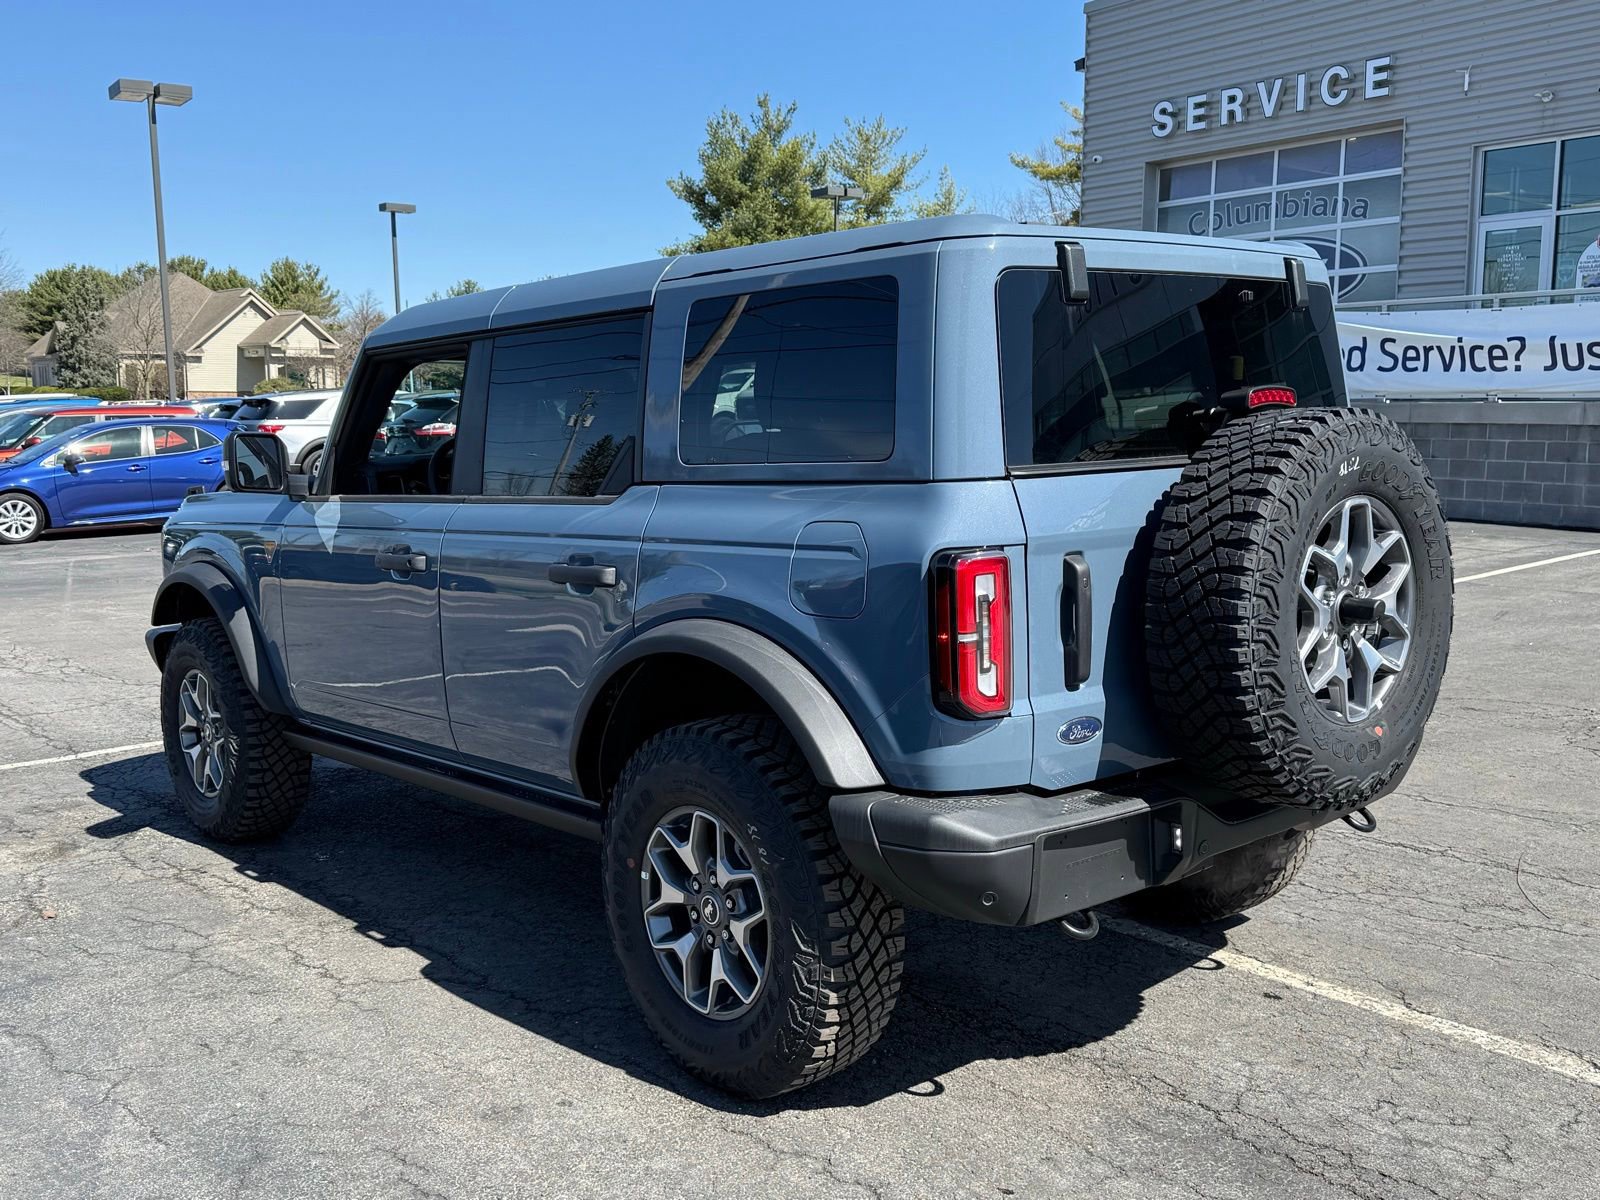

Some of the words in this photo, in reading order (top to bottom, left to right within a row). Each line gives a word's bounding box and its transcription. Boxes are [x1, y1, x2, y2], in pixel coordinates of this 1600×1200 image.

[1152, 55, 1393, 138] SERVICE
[1188, 191, 1370, 236] Columbiana
[1342, 337, 1368, 372] d
[1377, 336, 1527, 372] Service?
[1543, 335, 1600, 372] Jus
[1358, 460, 1445, 580] GOODYEAR
